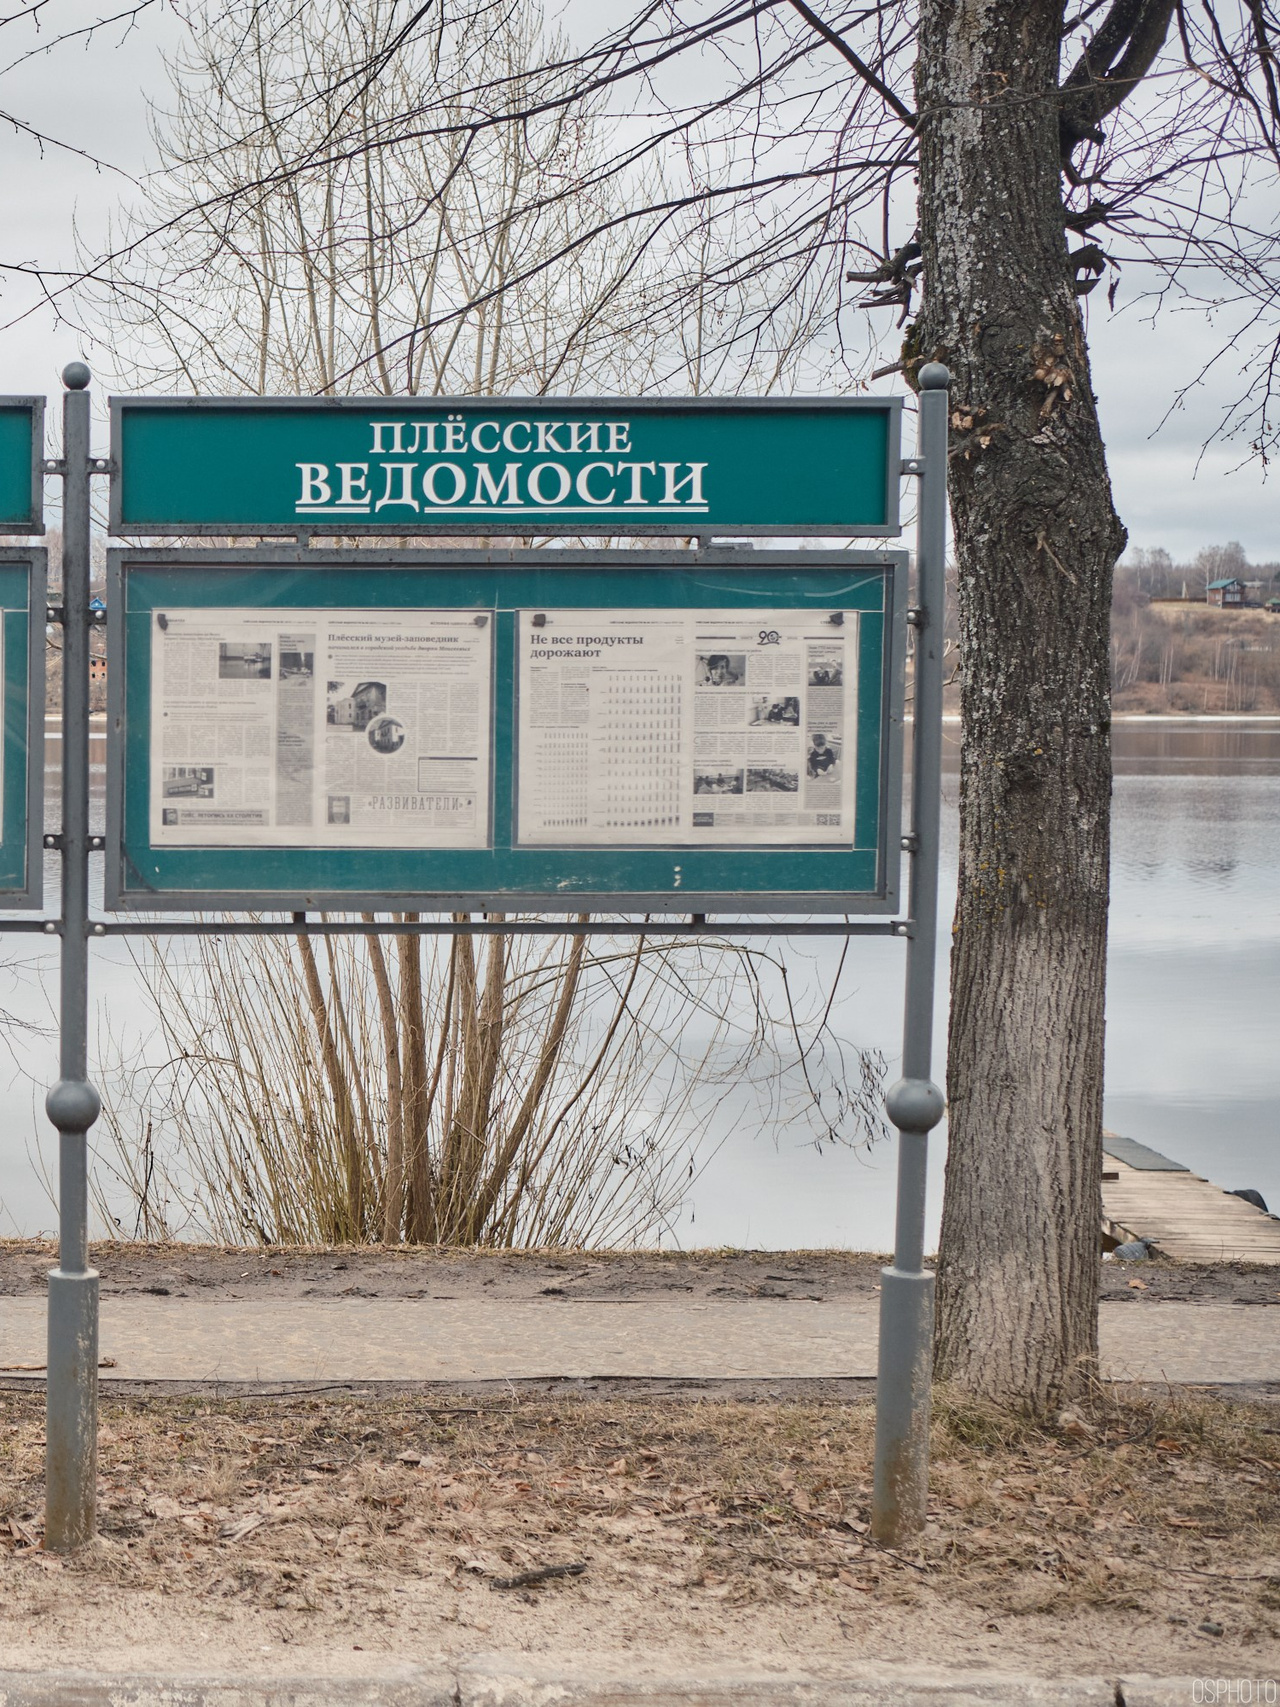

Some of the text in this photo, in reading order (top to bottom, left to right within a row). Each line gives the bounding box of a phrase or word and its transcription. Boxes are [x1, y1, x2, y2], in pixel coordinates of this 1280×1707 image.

[369, 415, 632, 453] ПЛЁССКИЕ
[296, 461, 709, 510] ВЕДОМОСТИ
[328, 633, 459, 644] Плёсский музей-заповедник
[530, 634, 644, 647] Не все продукты
[530, 650, 602, 660] дорожают
